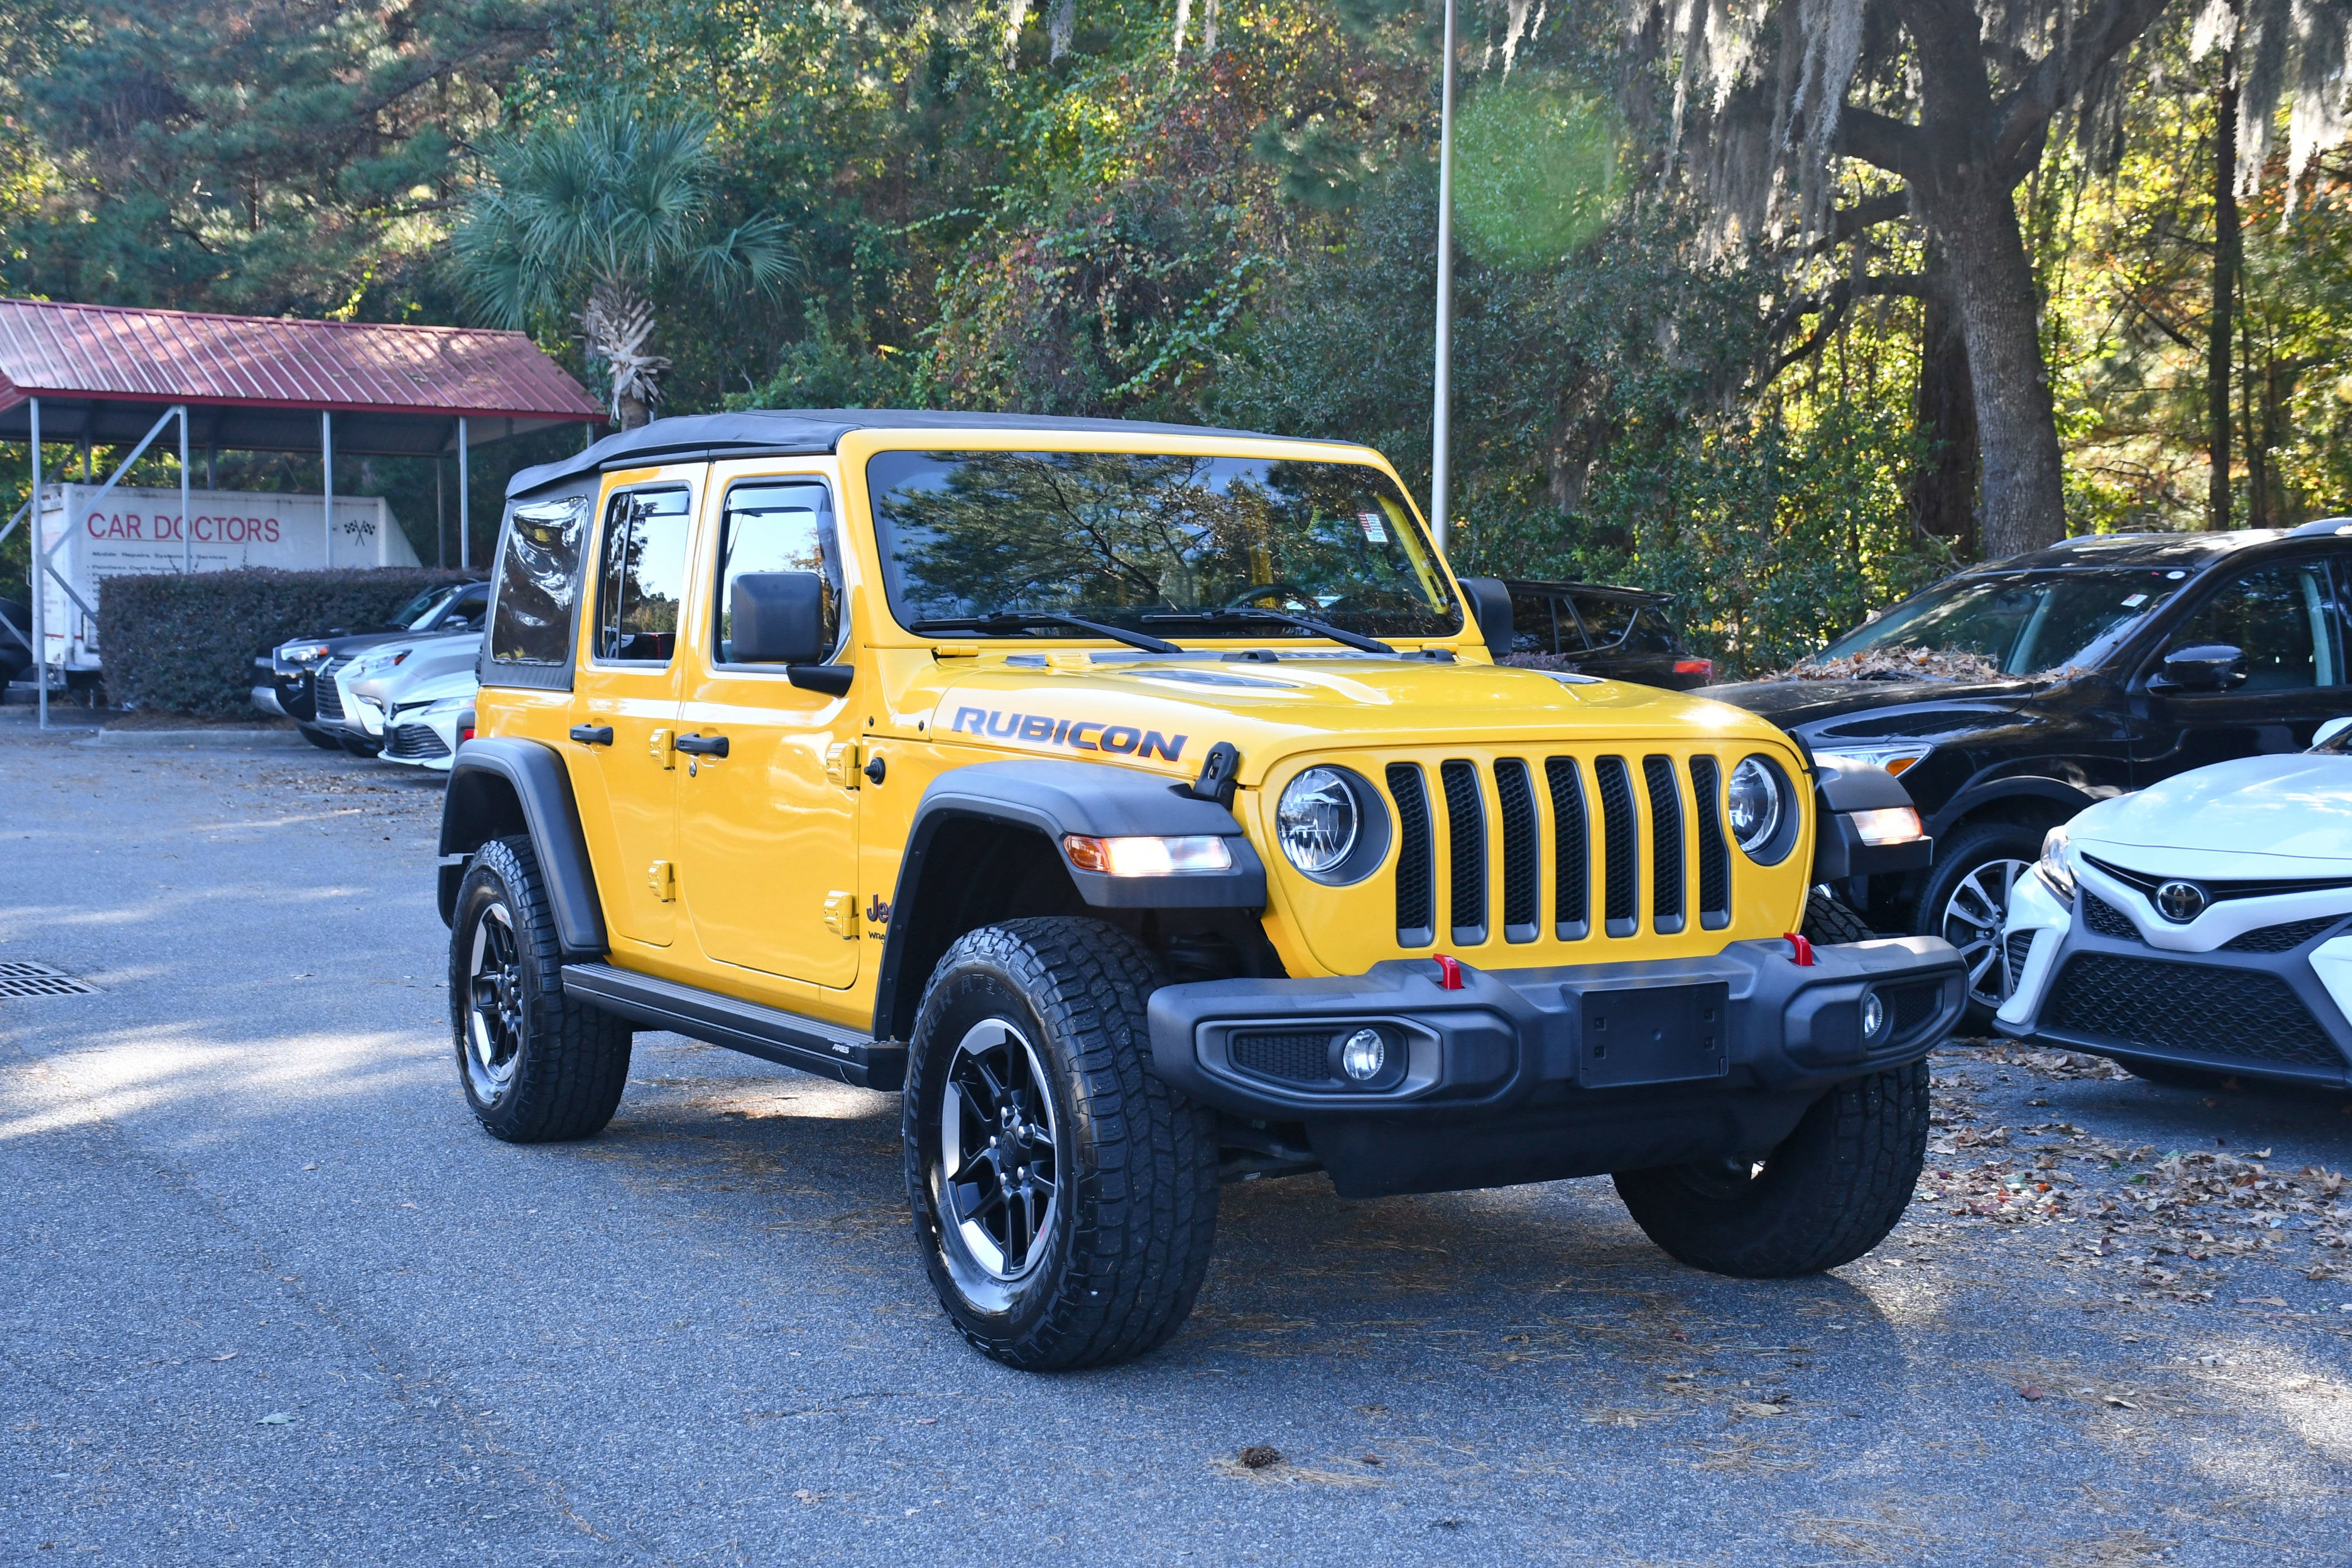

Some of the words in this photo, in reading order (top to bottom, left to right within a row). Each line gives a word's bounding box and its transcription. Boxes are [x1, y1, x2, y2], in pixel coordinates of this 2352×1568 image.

[87, 513, 142, 538] CAR
[154, 515, 280, 542] DOCTORS
[951, 706, 1188, 762] RUBICON
[866, 893, 889, 924] Je
